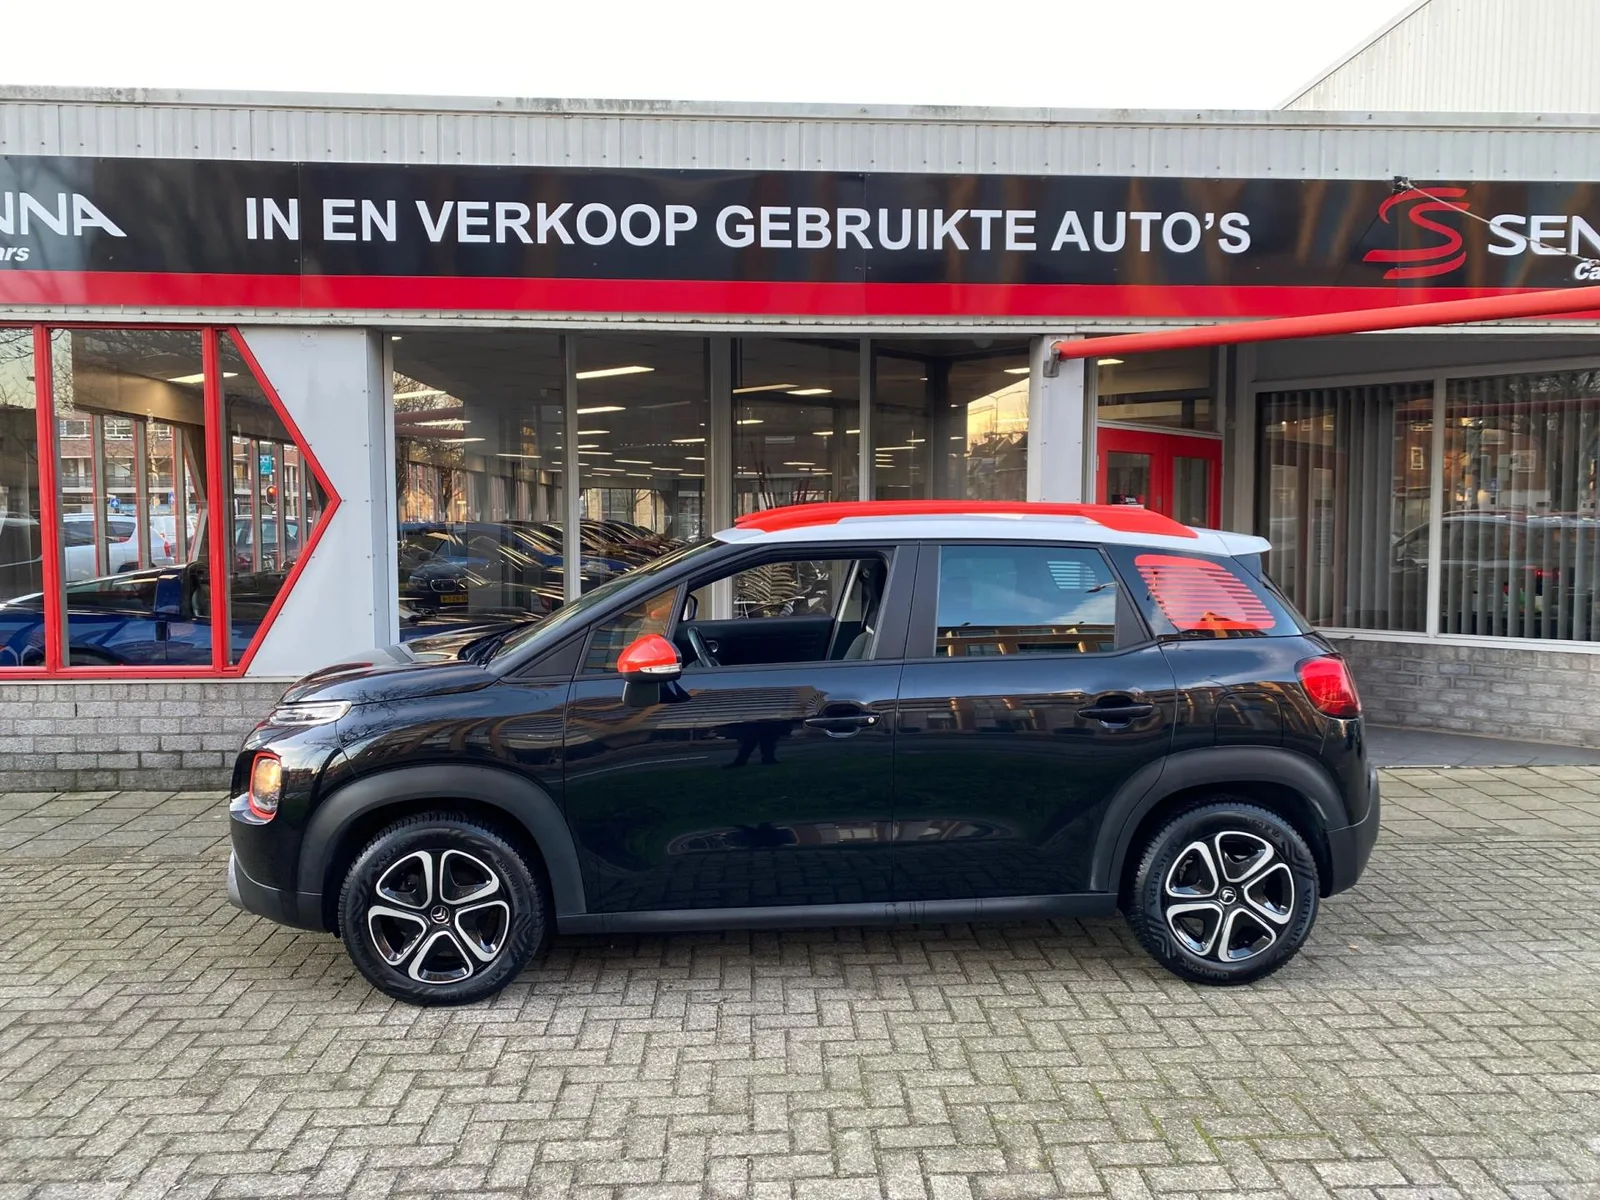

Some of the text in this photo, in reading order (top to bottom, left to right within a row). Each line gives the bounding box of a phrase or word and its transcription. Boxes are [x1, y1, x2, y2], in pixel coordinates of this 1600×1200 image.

[247, 198, 1251, 254] IN EN VERKOOP GEBRUIKTE AUTO'S
